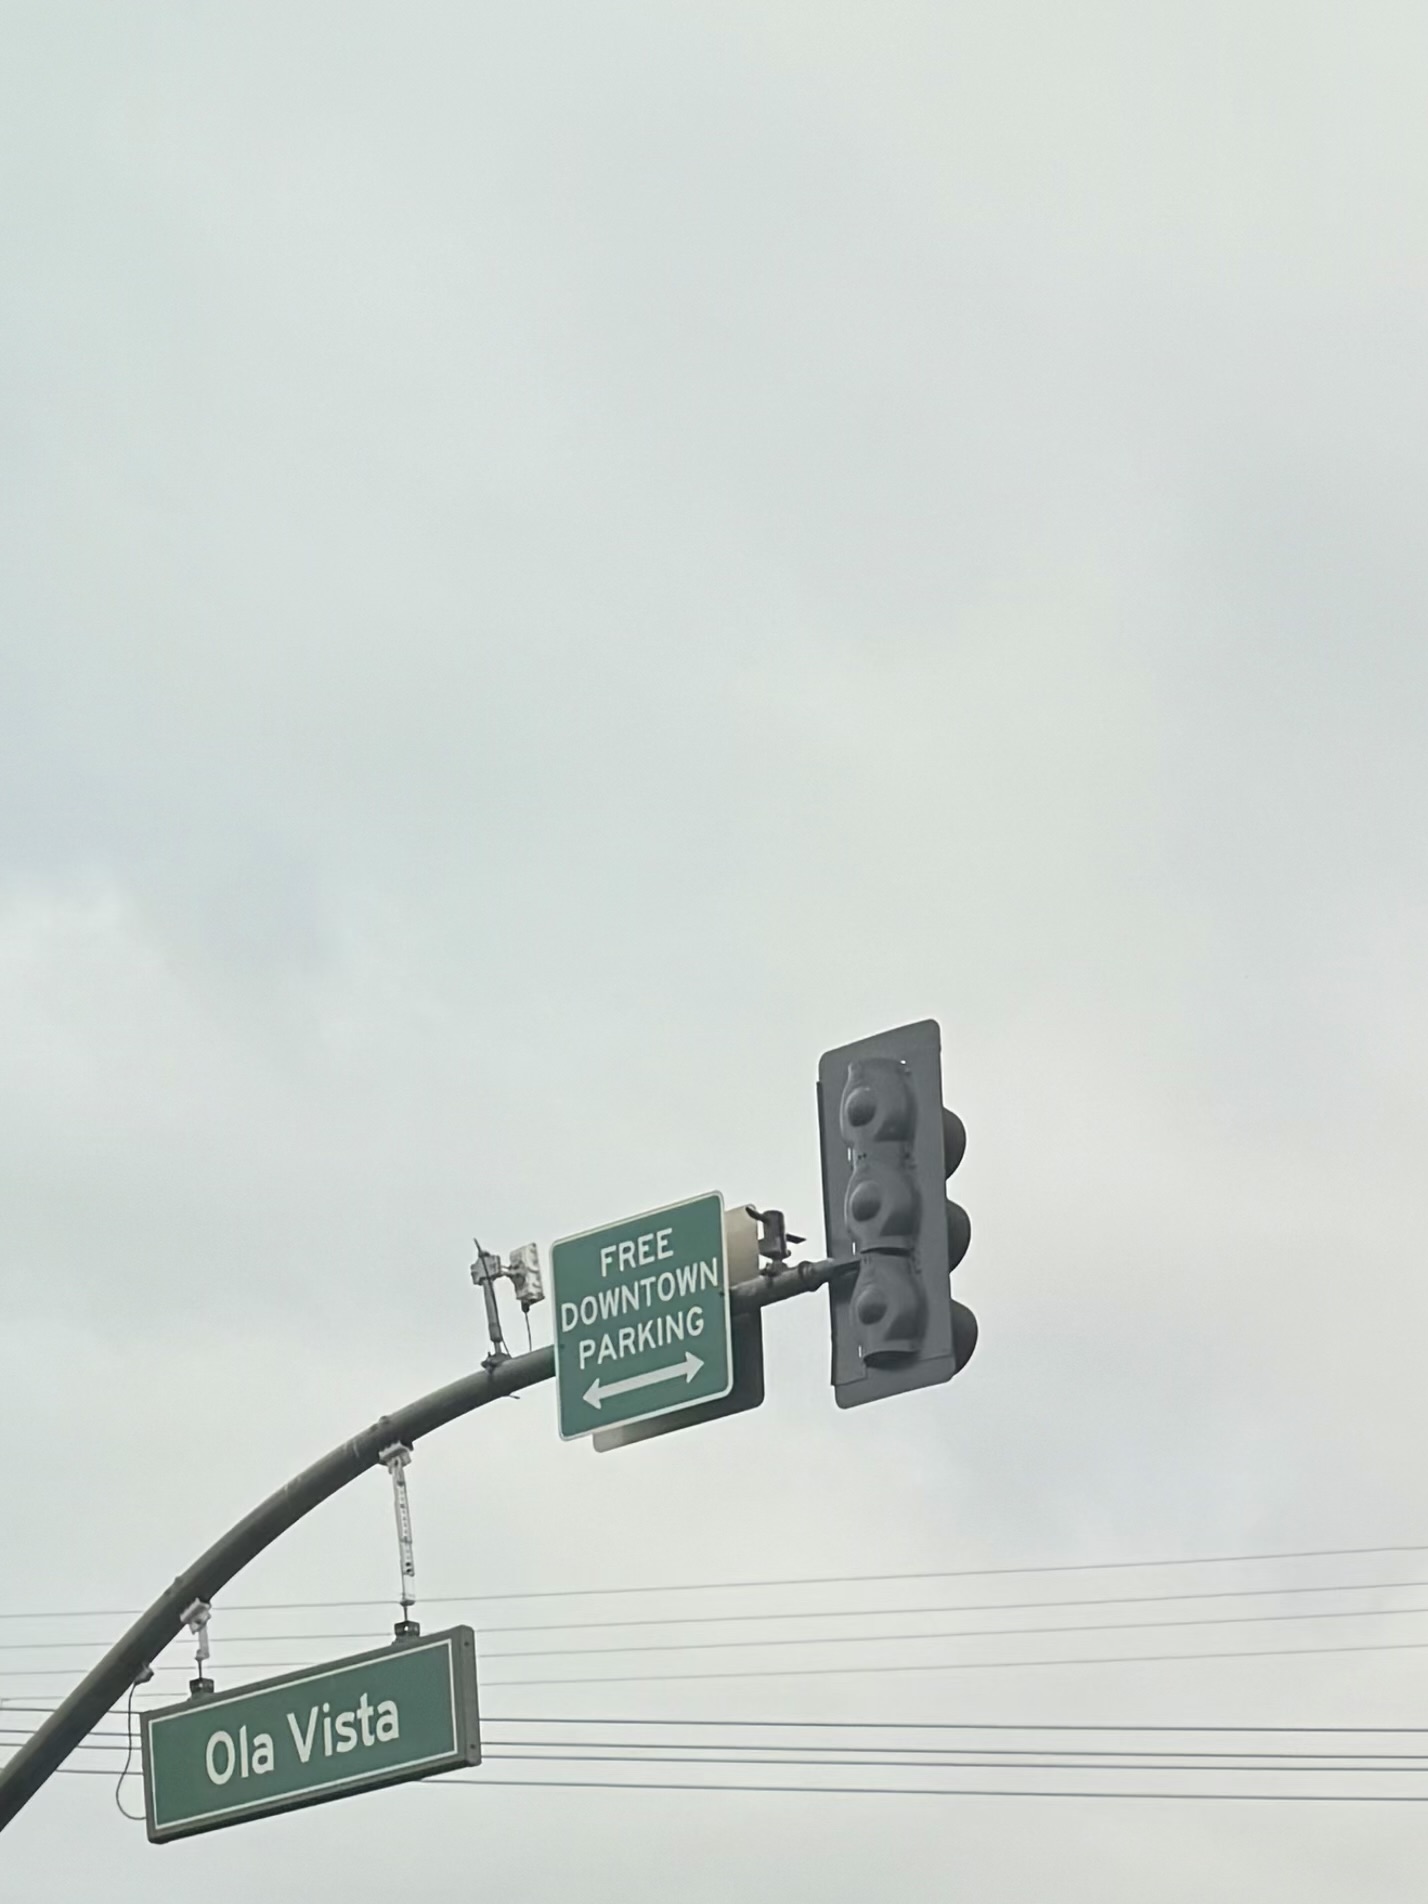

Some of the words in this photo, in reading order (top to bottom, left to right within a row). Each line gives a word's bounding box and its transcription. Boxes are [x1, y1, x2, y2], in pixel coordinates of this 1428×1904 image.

[600, 1228, 674, 1277] FREE
[561, 1257, 718, 1332] DOWNTOWN
[579, 1306, 704, 1369] PARKING
[206, 1725, 274, 1785] Ola
[287, 1692, 399, 1763] Vista
